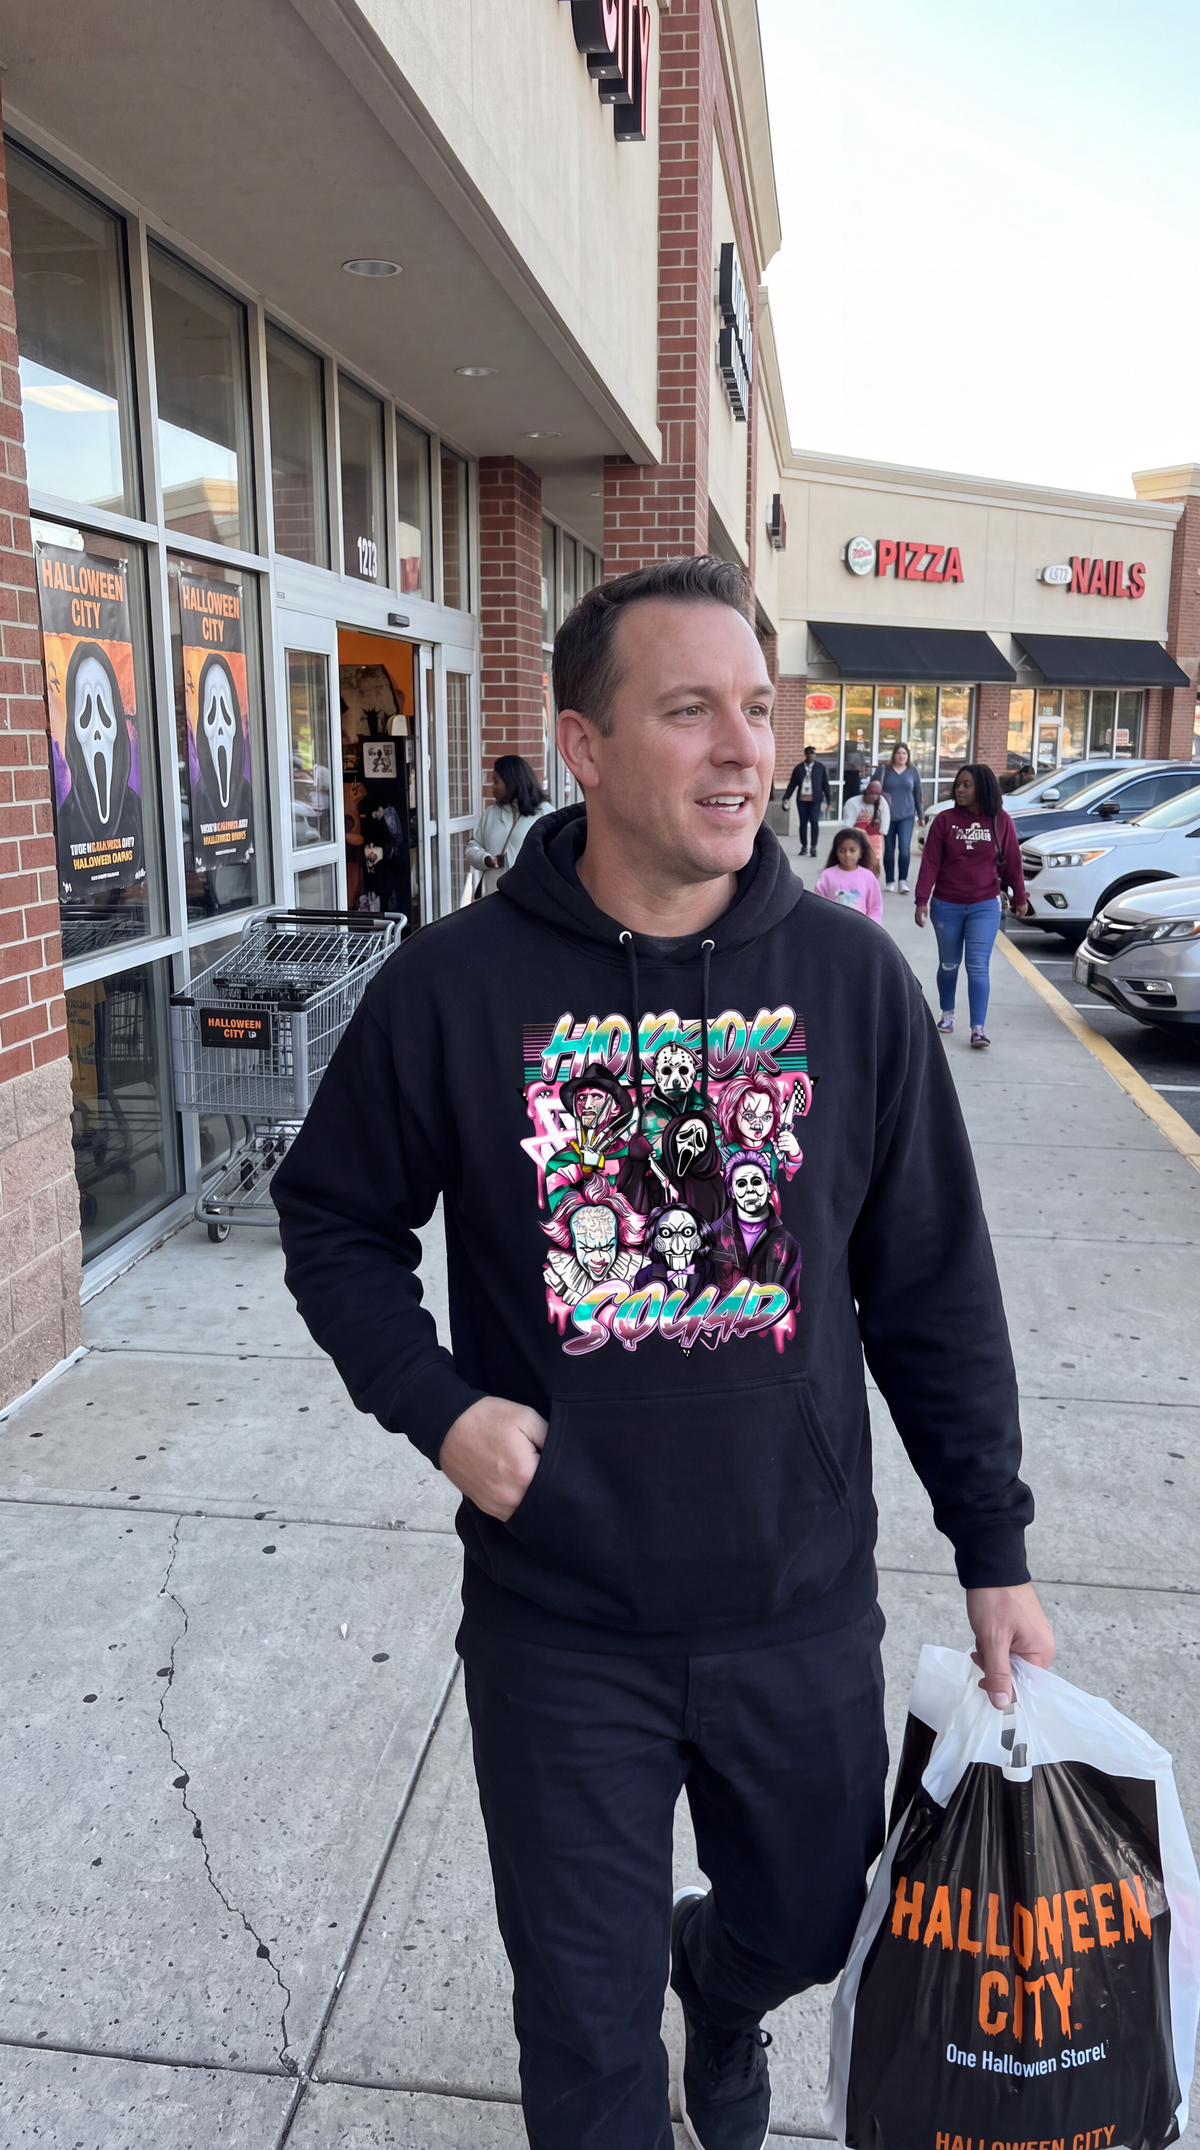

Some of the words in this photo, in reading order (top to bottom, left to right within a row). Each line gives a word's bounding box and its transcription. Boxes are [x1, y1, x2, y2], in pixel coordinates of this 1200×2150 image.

[876, 539, 964, 583] PIZZA
[41, 558, 124, 602] HALLOWEEN
[1067, 556, 1146, 599] NAILS
[71, 598, 101, 629] CITY
[182, 584, 240, 619] HALLOWEEN
[202, 616, 224, 643] CITY
[207, 1017, 262, 1030] HALLOWEEN
[223, 1028, 245, 1039] CITY
[978, 1967, 1074, 2048] CITY
[946, 2043, 977, 2068] One
[1072, 2124, 1116, 2150] CITY
